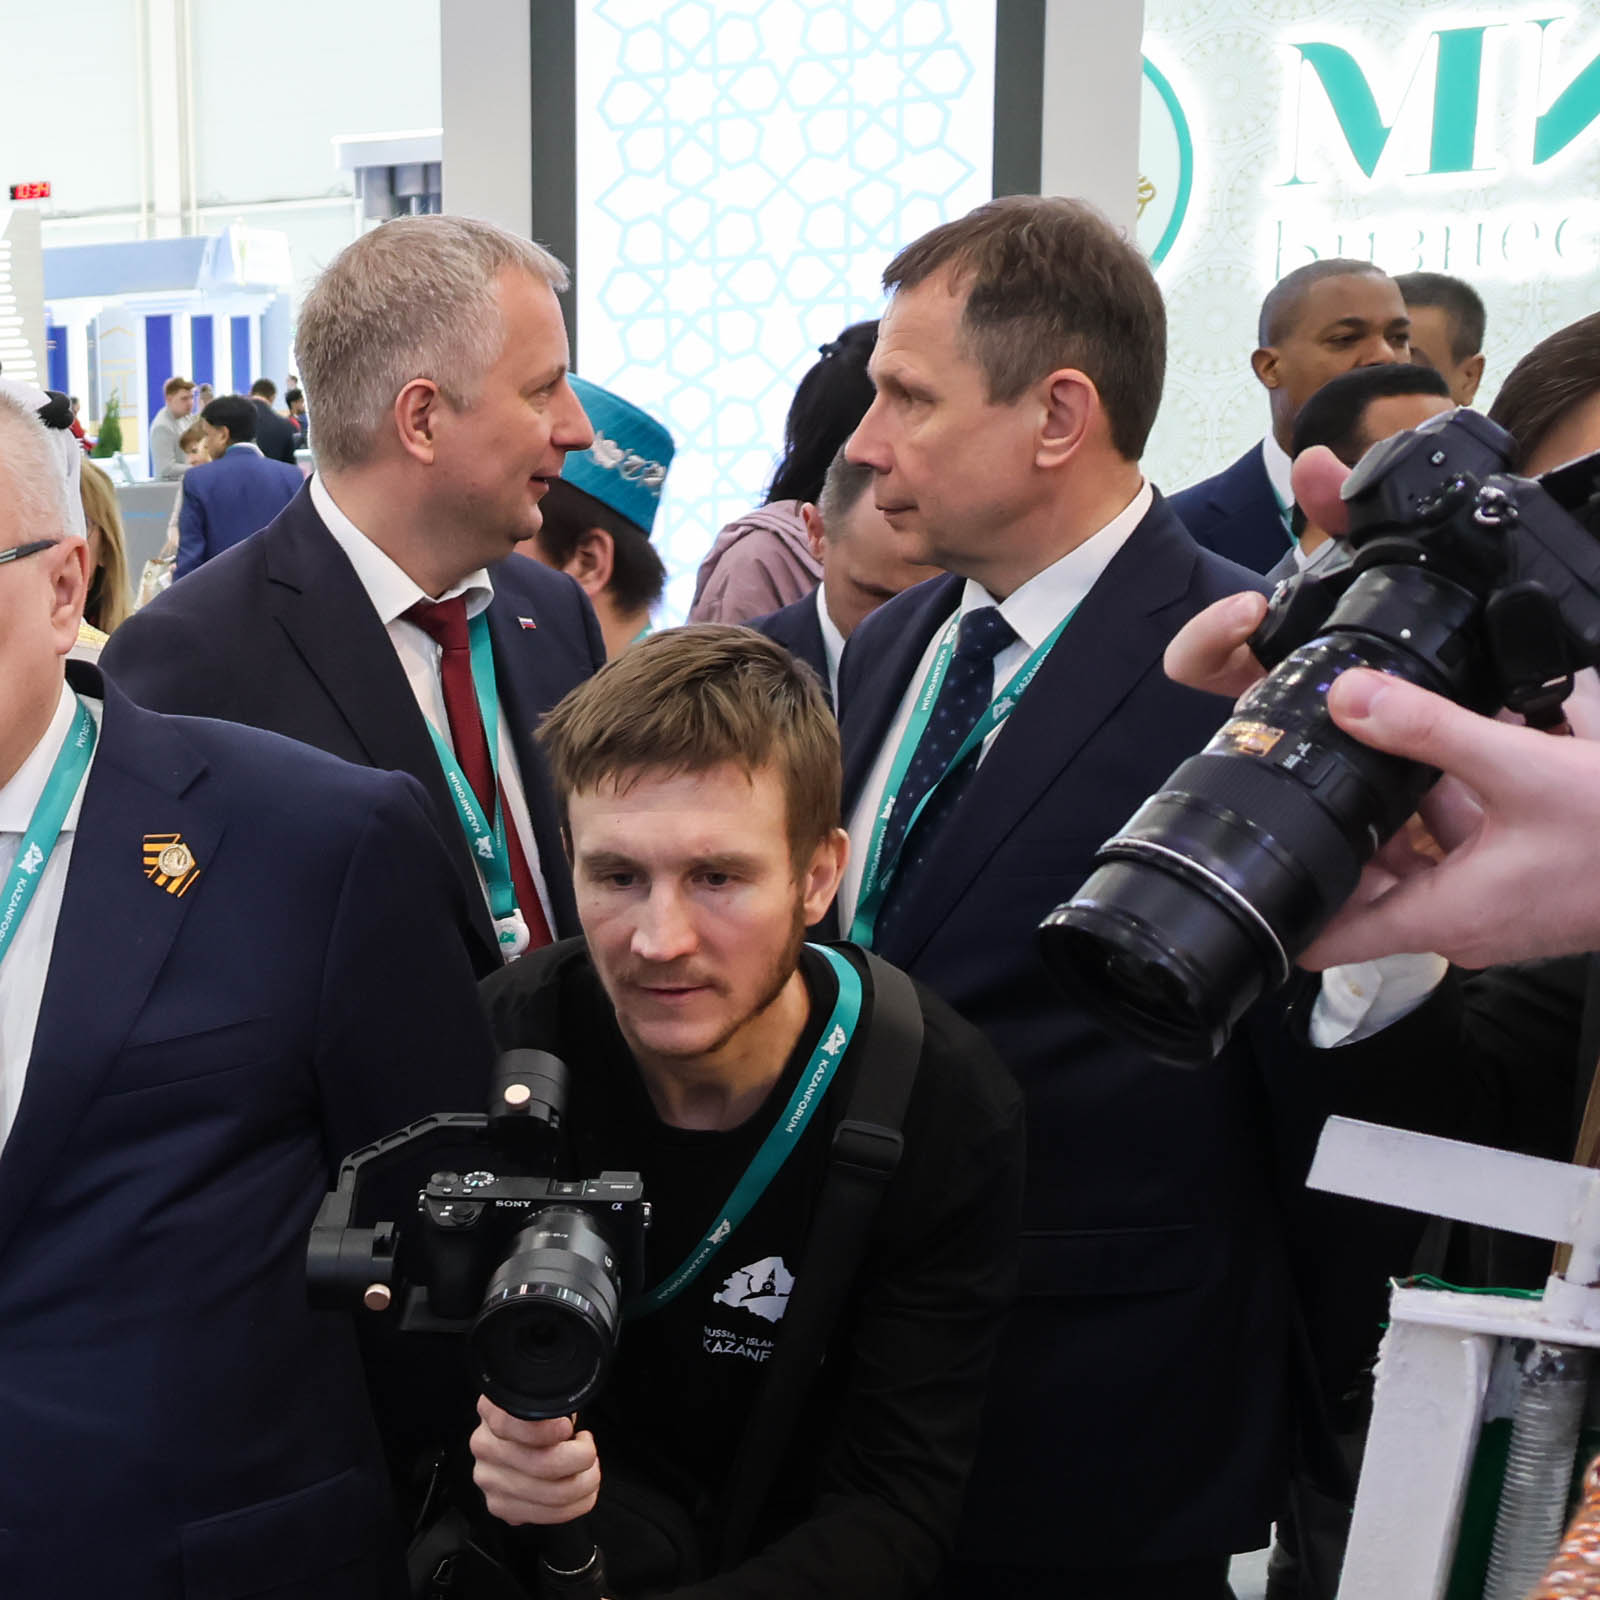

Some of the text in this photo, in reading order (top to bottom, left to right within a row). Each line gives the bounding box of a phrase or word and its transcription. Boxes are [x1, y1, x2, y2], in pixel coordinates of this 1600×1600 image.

[921, 647, 947, 712] KAZANFORUM
[448, 771, 482, 834] KAZANFORUM
[785, 1058, 830, 1134] KAZANFORUM
[496, 1200, 531, 1208] SONY
